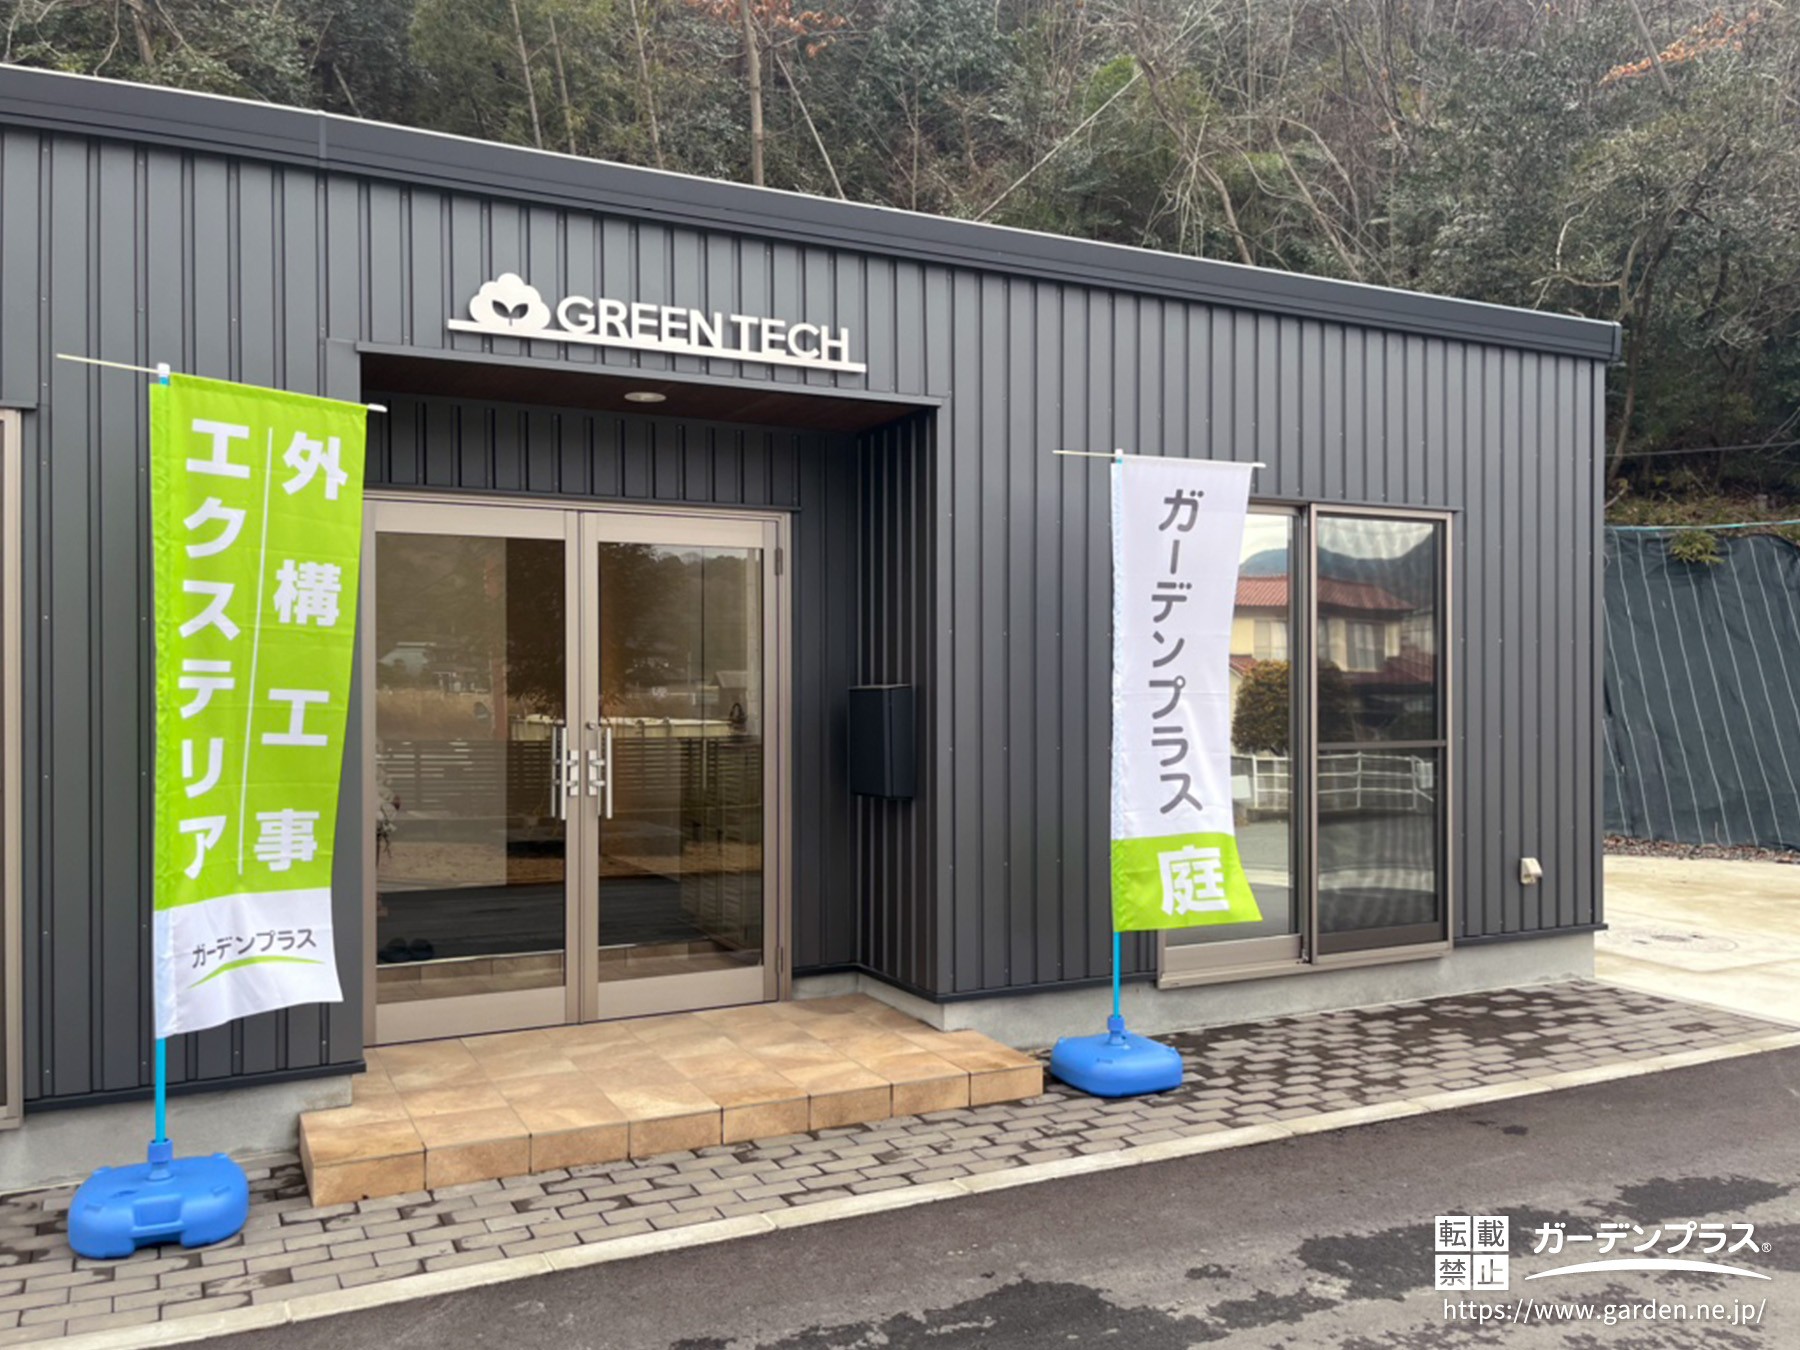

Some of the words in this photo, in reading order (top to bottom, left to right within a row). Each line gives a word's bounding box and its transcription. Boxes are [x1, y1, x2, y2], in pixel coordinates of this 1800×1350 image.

[557, 295, 722, 349] GREEN
[730, 314, 849, 362] TECH
[178, 418, 250, 880] エクステリア
[254, 430, 348, 872] 外構工事
[1149, 489, 1204, 814] ガーデンプラス
[191, 928, 317, 969] ガーデンプラス
[1157, 845, 1230, 916] 庭
